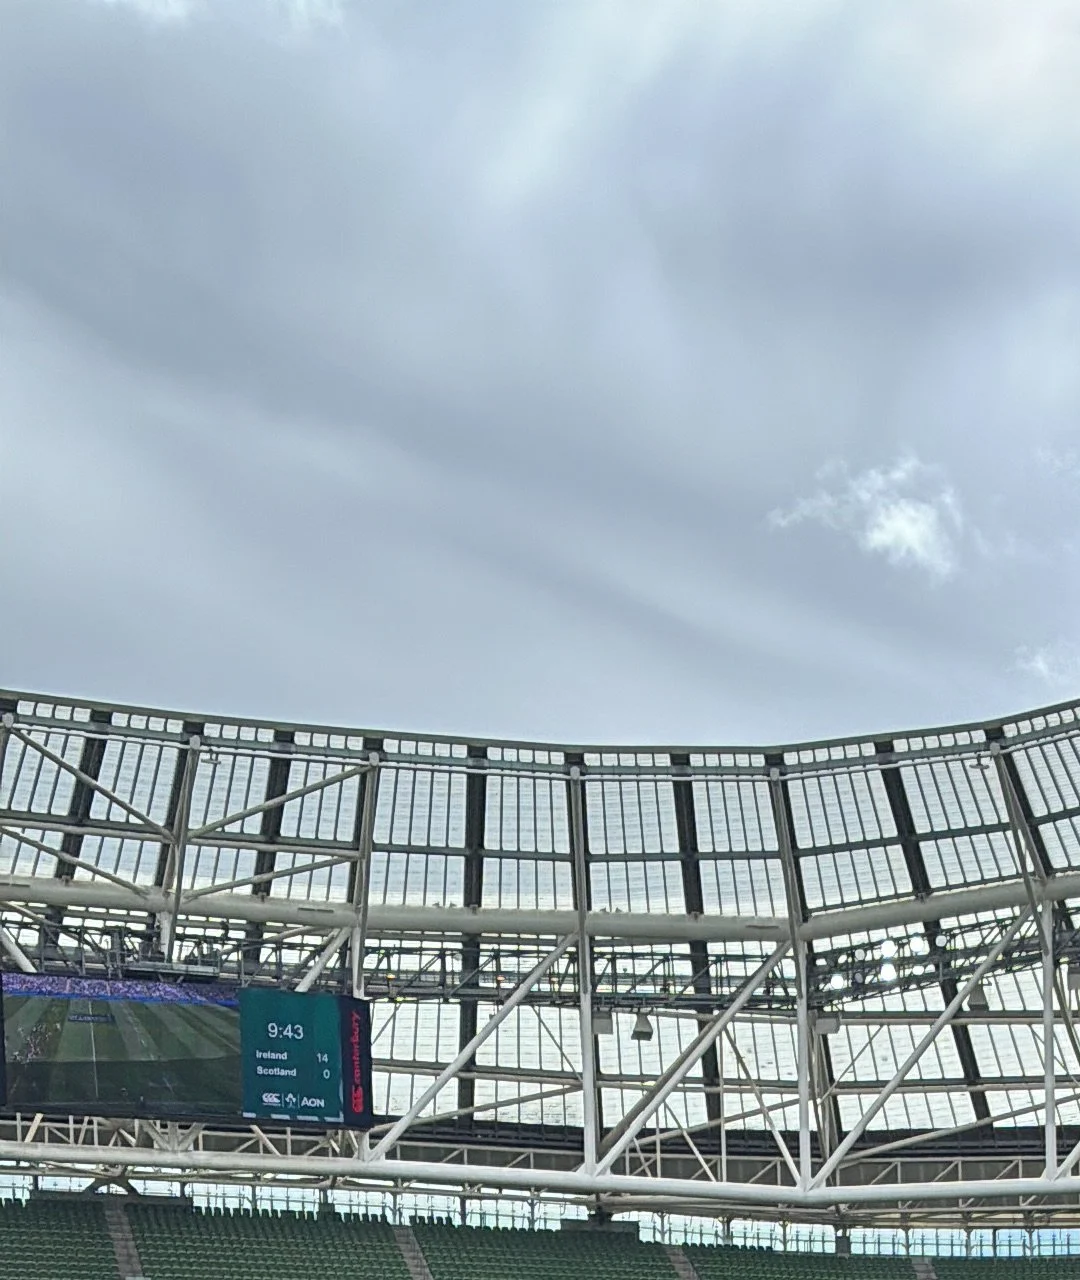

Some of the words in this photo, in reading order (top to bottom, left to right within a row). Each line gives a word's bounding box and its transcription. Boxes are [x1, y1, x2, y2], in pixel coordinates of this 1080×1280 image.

[268, 1022, 304, 1040] 9:43
[256, 1050, 288, 1060] Ireland
[316, 1053, 329, 1063] 14
[256, 1066, 297, 1077] Scotland
[323, 1069, 331, 1079] 0
[301, 1097, 325, 1108] AON
